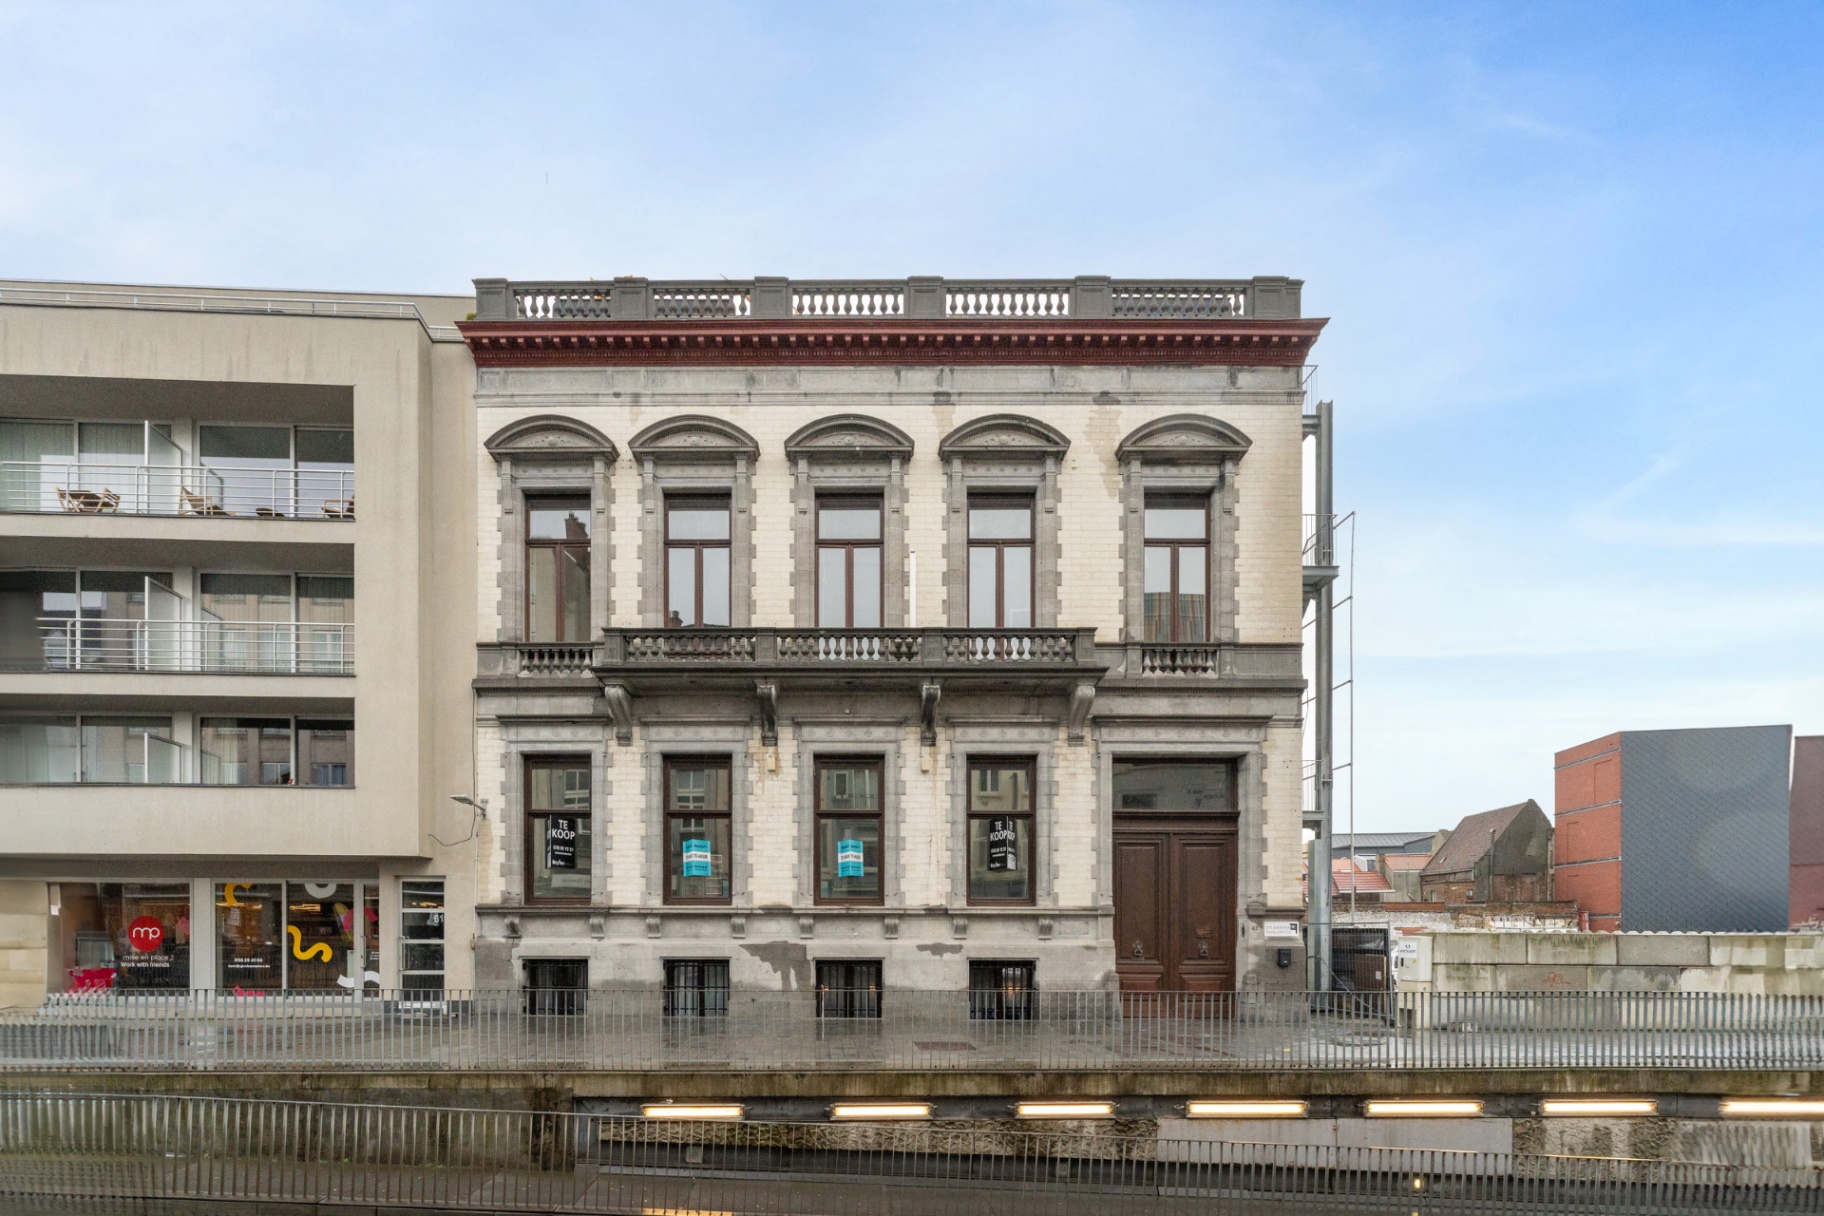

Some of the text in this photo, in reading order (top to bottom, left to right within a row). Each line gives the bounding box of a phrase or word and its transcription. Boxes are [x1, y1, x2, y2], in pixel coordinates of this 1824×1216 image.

[558, 819, 568, 830] TE
[994, 821, 1002, 830] TE
[552, 828, 576, 840] KOOP
[990, 830, 1007, 842] KOOP
[433, 914, 444, 923] 61
[132, 927, 160, 940] mp
